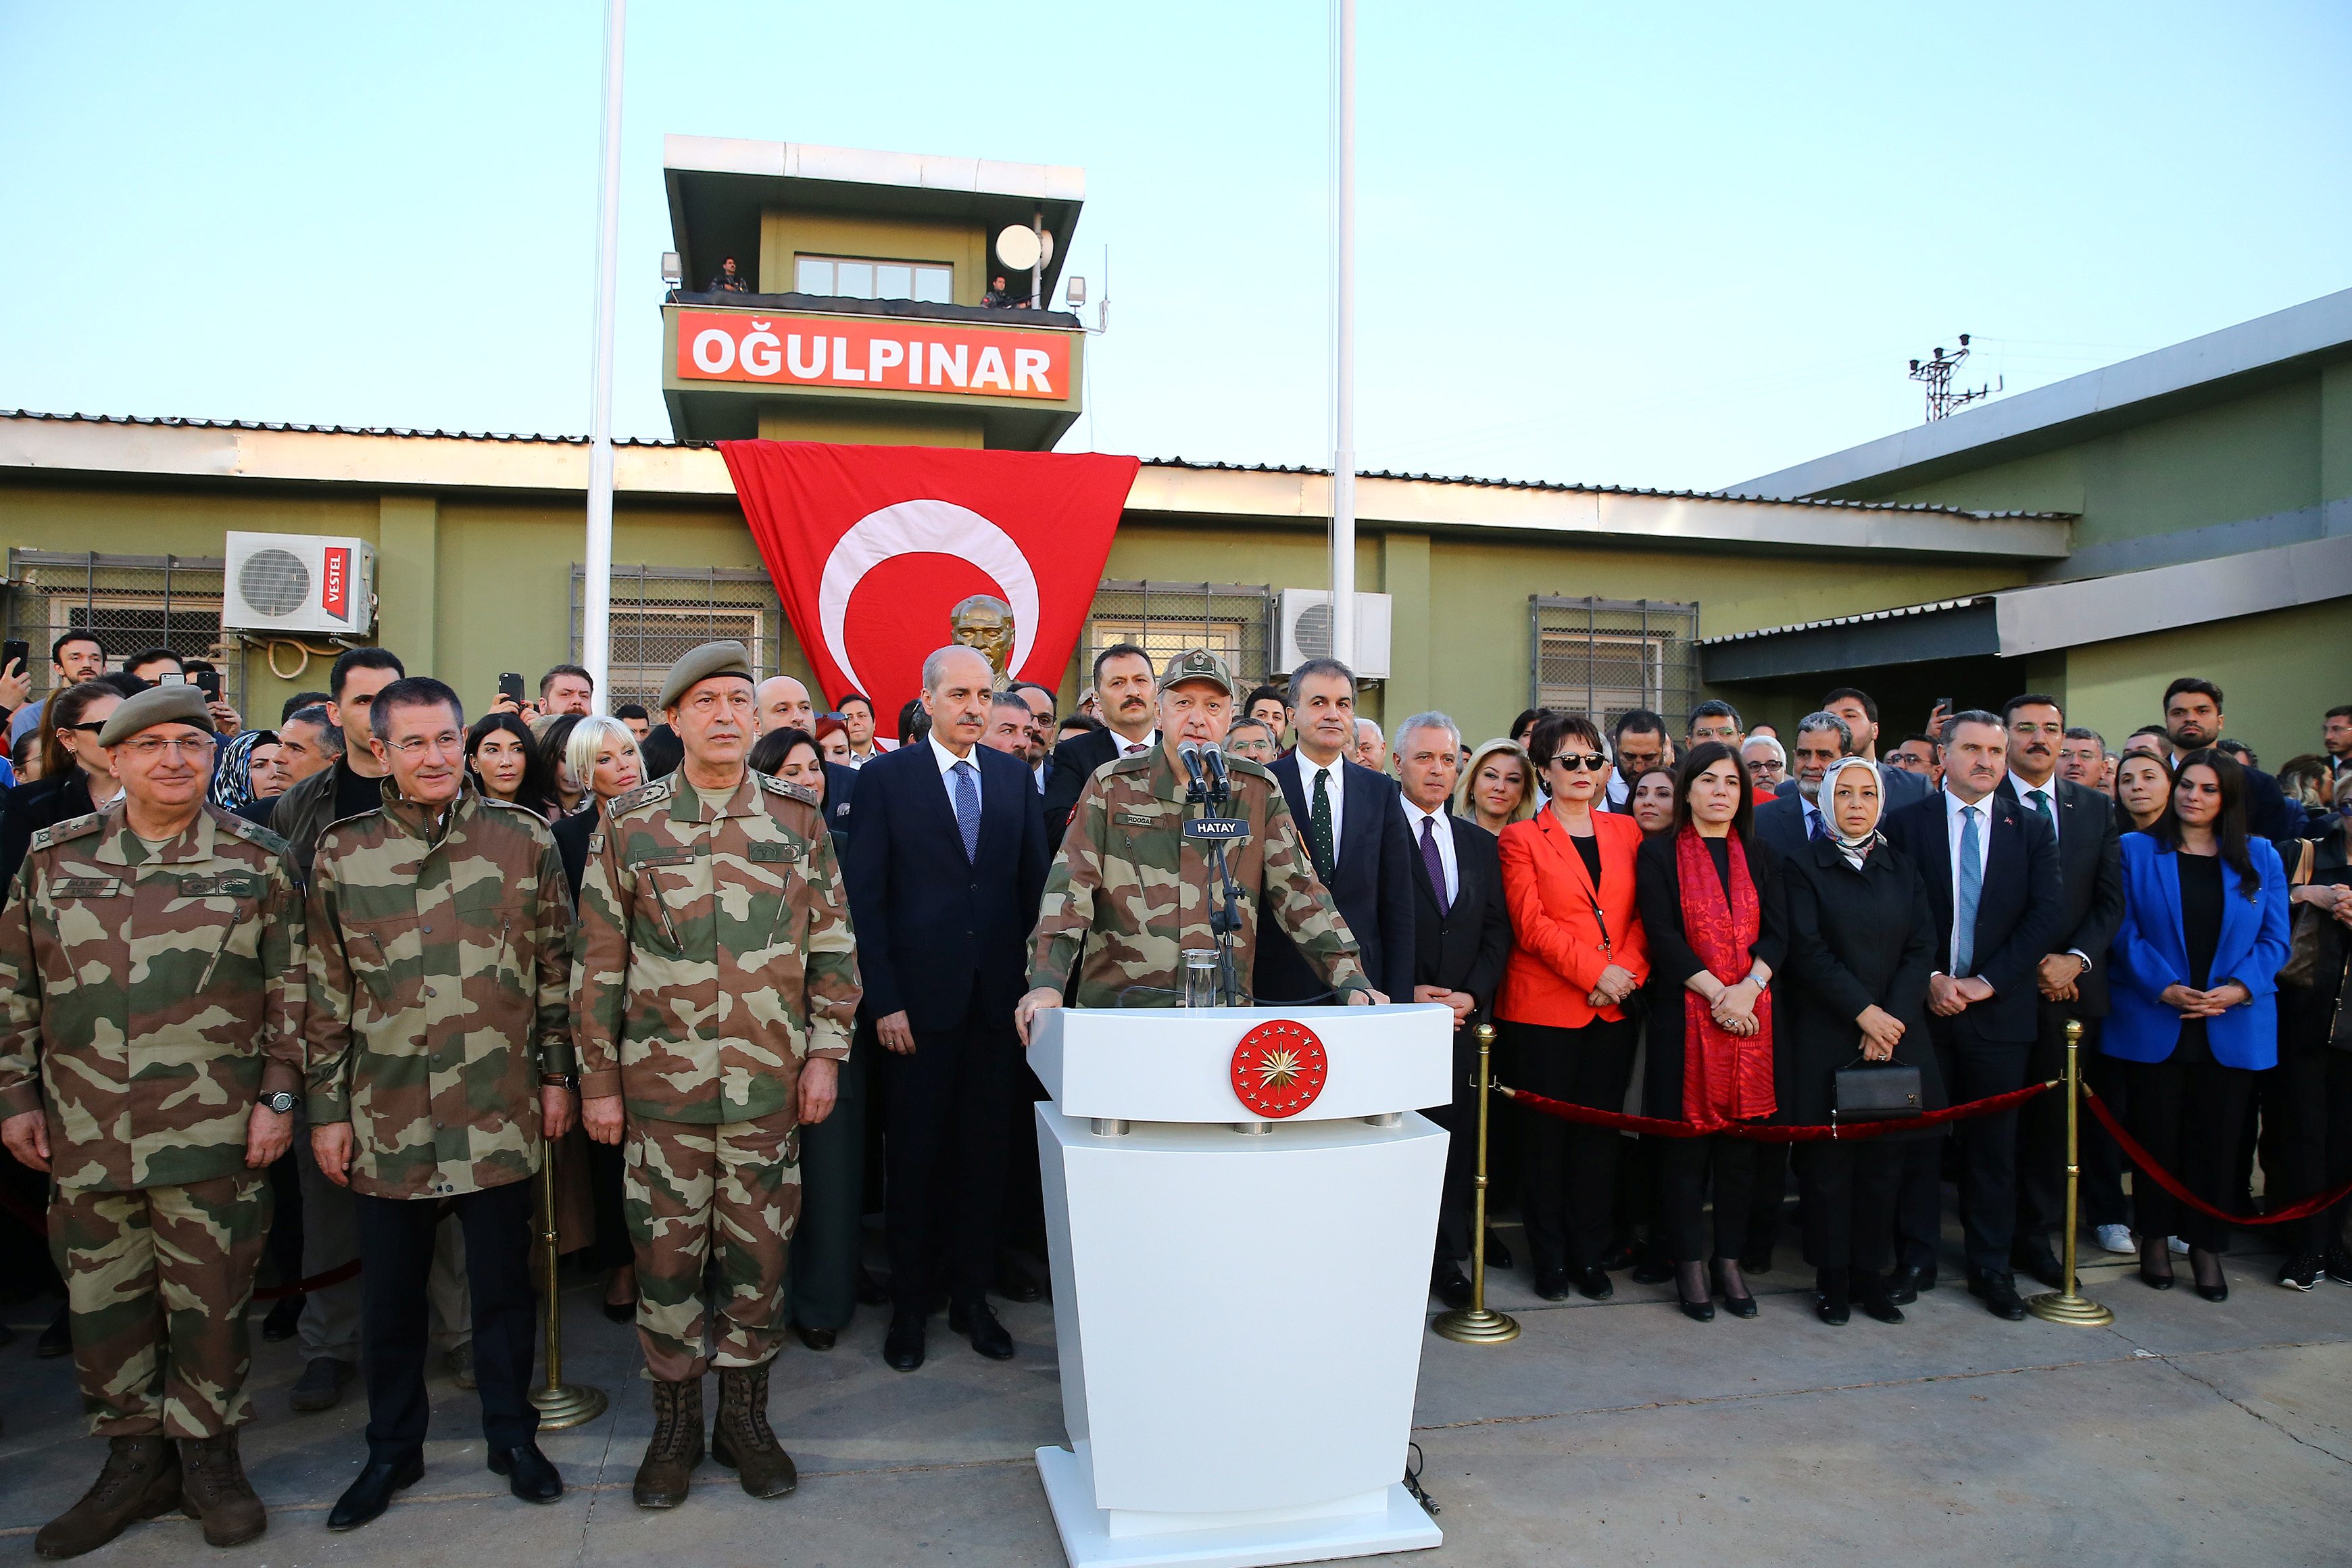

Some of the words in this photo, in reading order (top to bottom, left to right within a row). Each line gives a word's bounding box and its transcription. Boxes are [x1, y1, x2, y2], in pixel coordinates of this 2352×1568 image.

[691, 321, 1052, 393] OĞULPINAR
[328, 554, 341, 603] VESTEL
[1125, 816, 1154, 825] RDOĞAN
[1197, 823, 1236, 833] HATAY
